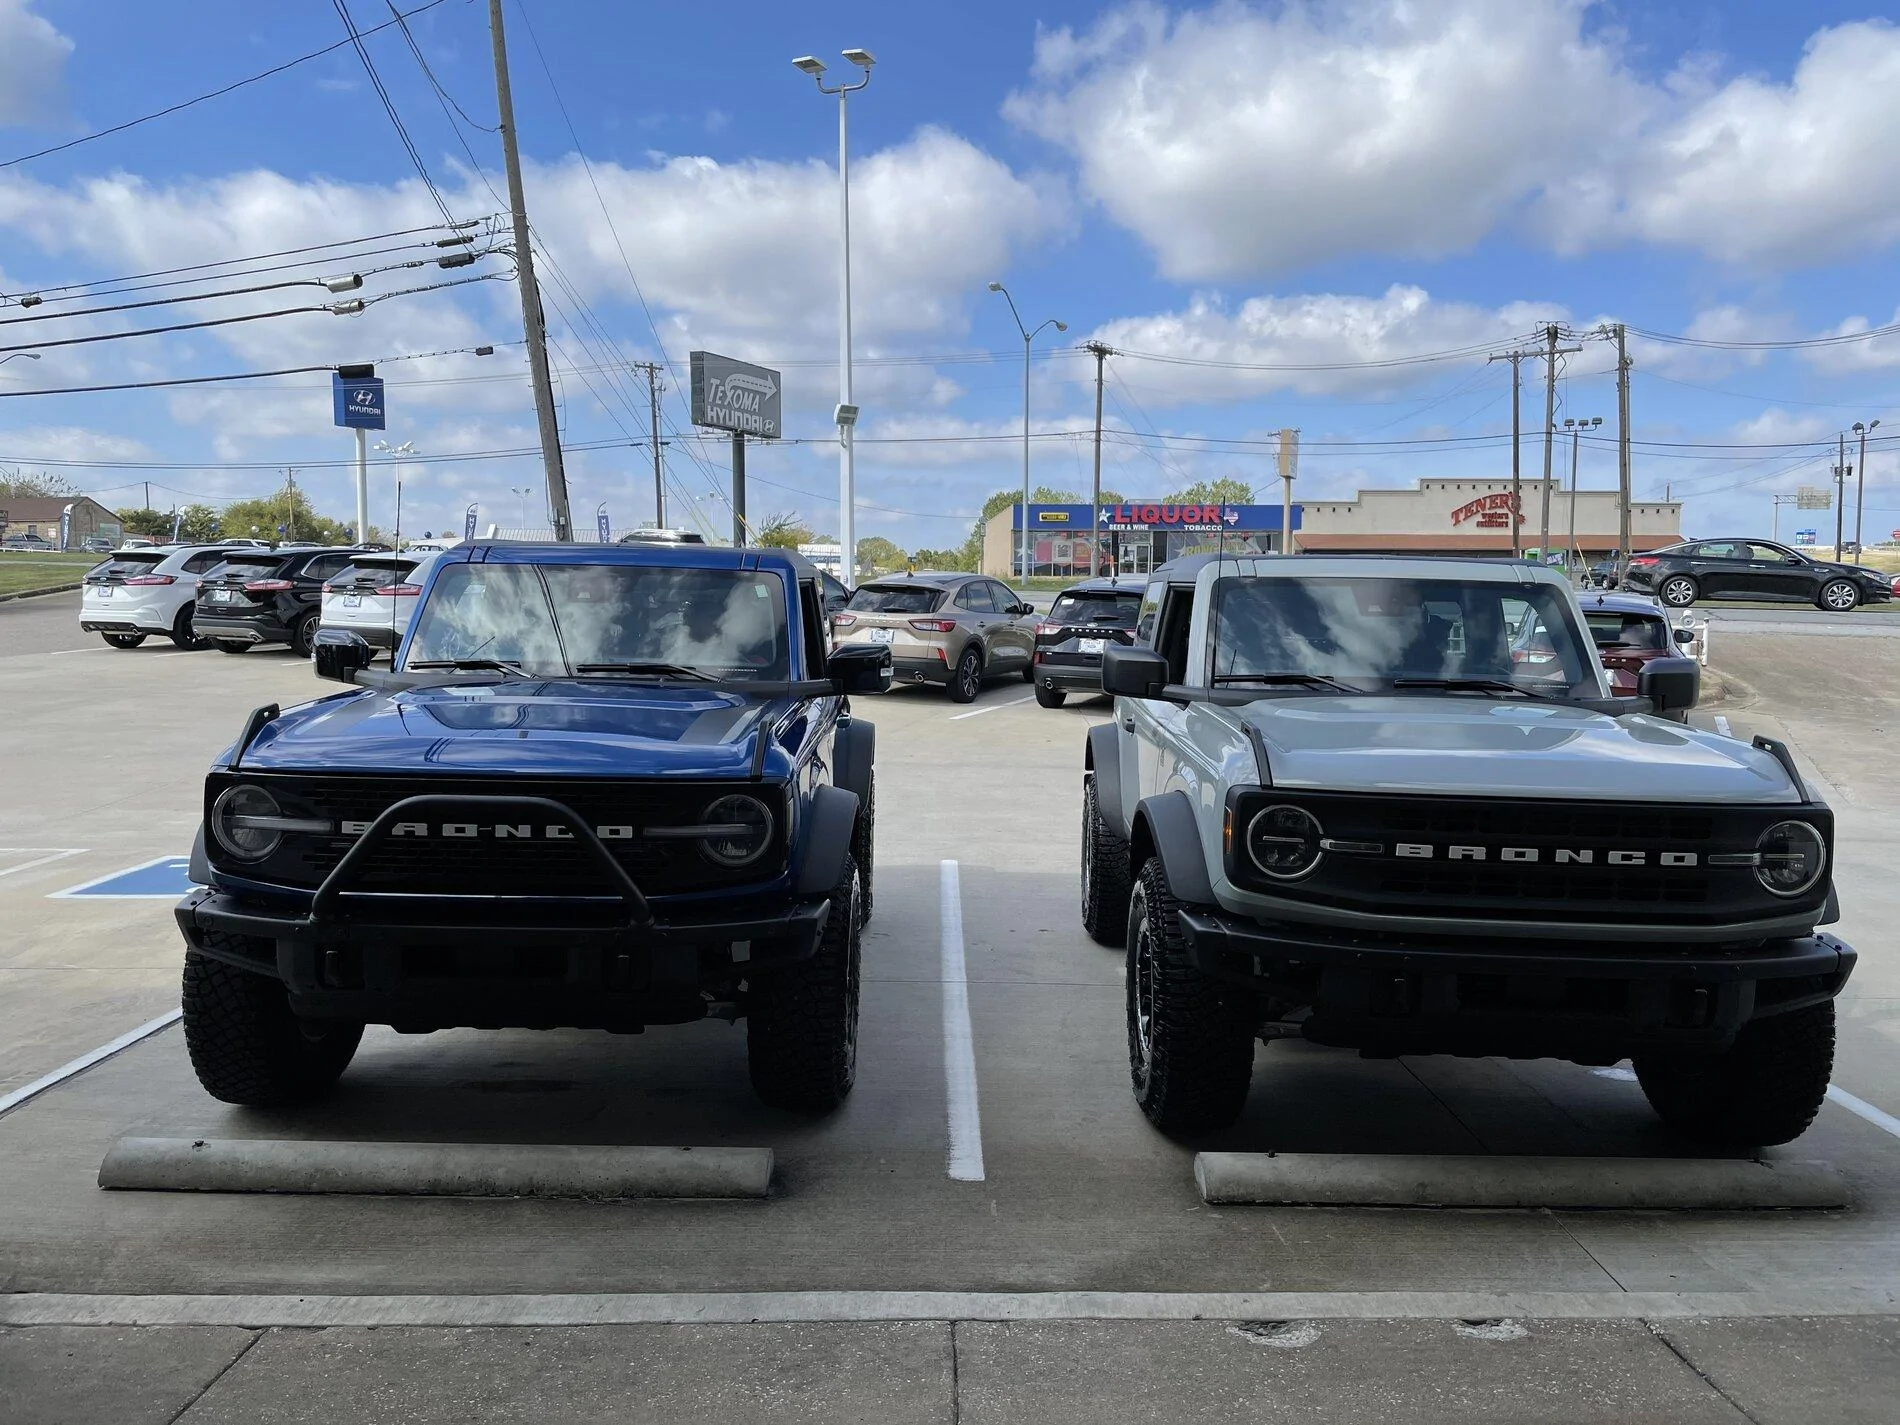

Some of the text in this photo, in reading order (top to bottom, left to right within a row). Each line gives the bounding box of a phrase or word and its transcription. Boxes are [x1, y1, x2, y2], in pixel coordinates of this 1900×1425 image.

[708, 377, 760, 412] TEXOMA
[349, 404, 381, 415] HYUNDAI
[707, 405, 763, 432] HYUNDAI
[1114, 503, 1221, 524] LIQUOR
[341, 821, 633, 839] BRONCO
[1395, 843, 1698, 866] BRONCO
